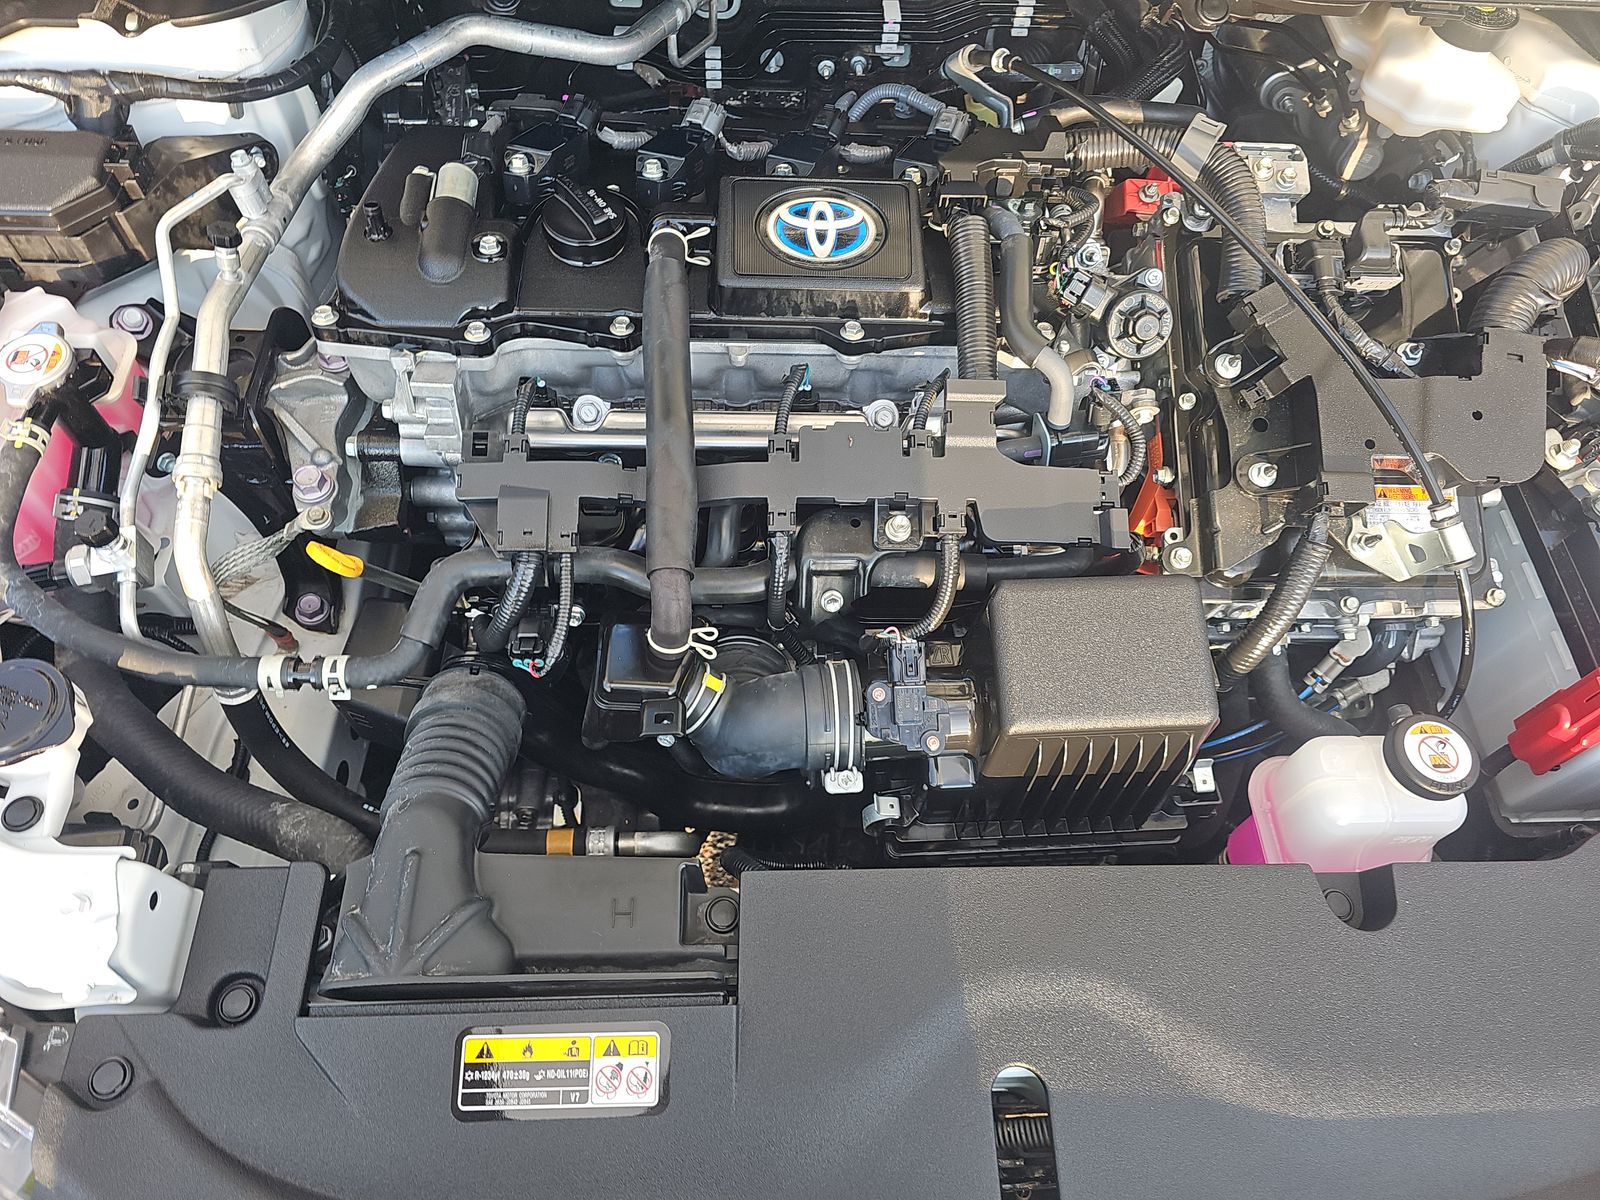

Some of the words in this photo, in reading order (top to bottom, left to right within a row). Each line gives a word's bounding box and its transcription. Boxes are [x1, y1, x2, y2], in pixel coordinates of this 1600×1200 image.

[586, 188, 607, 208] 0W-16
[603, 206, 618, 220] SAE
[611, 897, 634, 928] H
[518, 1091, 547, 1099] CORPORATION
[569, 1093, 580, 1104] V7
